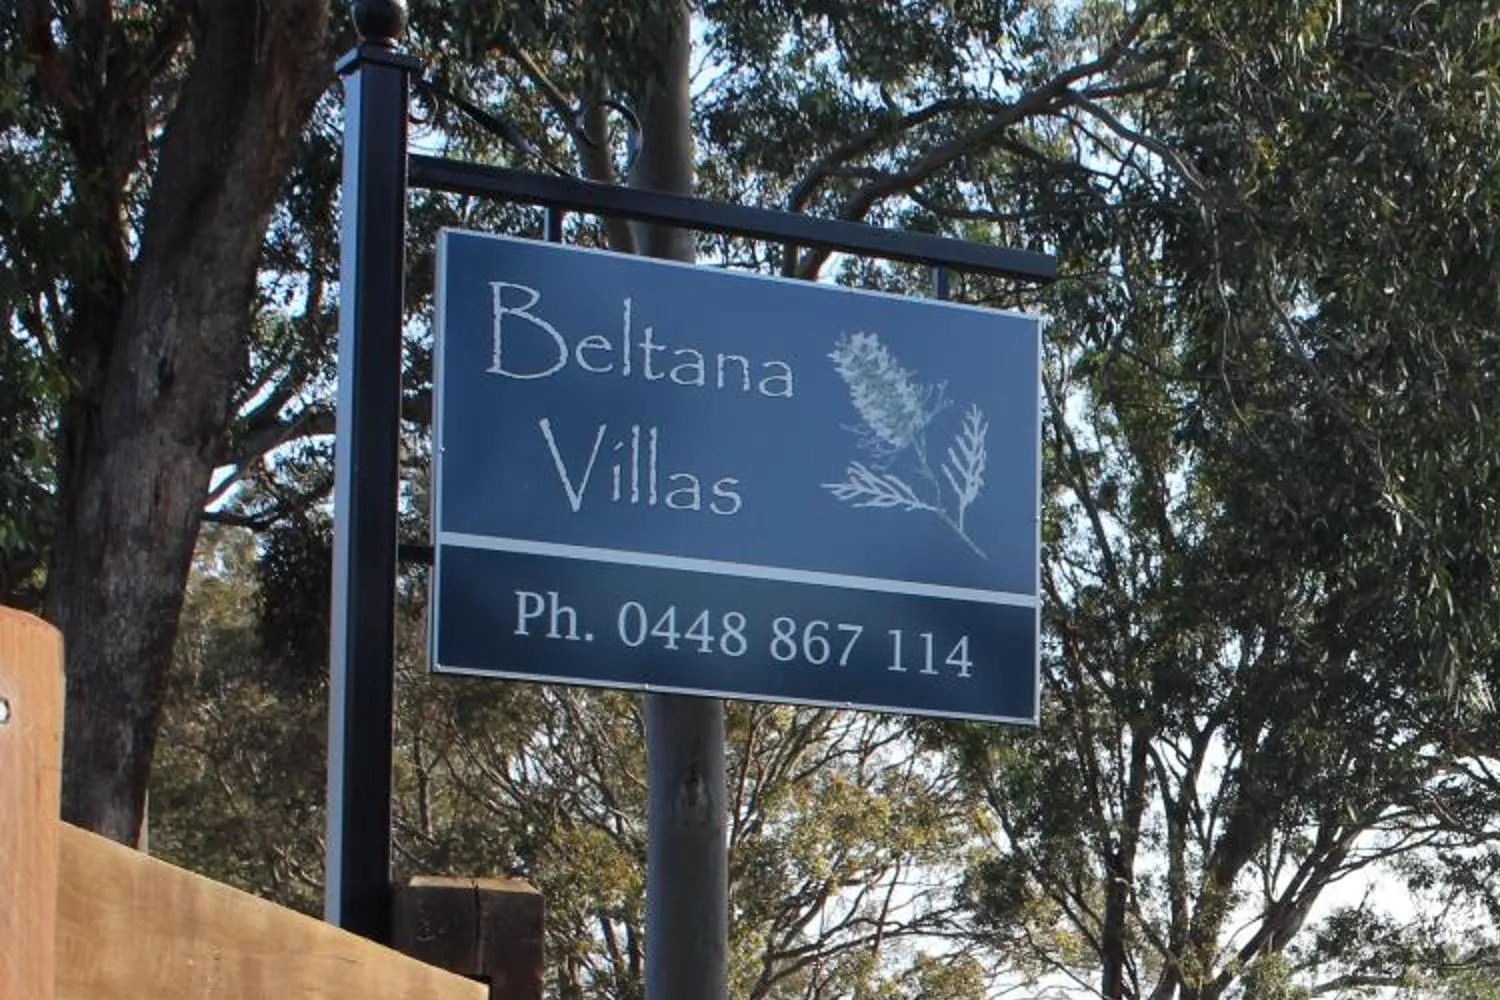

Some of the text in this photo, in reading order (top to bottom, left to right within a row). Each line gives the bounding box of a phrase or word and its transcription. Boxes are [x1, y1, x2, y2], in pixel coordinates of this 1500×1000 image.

[485, 280, 796, 399] Beltana
[538, 415, 743, 516] Villas
[514, 590, 975, 678] Ph. 0448 867 114
